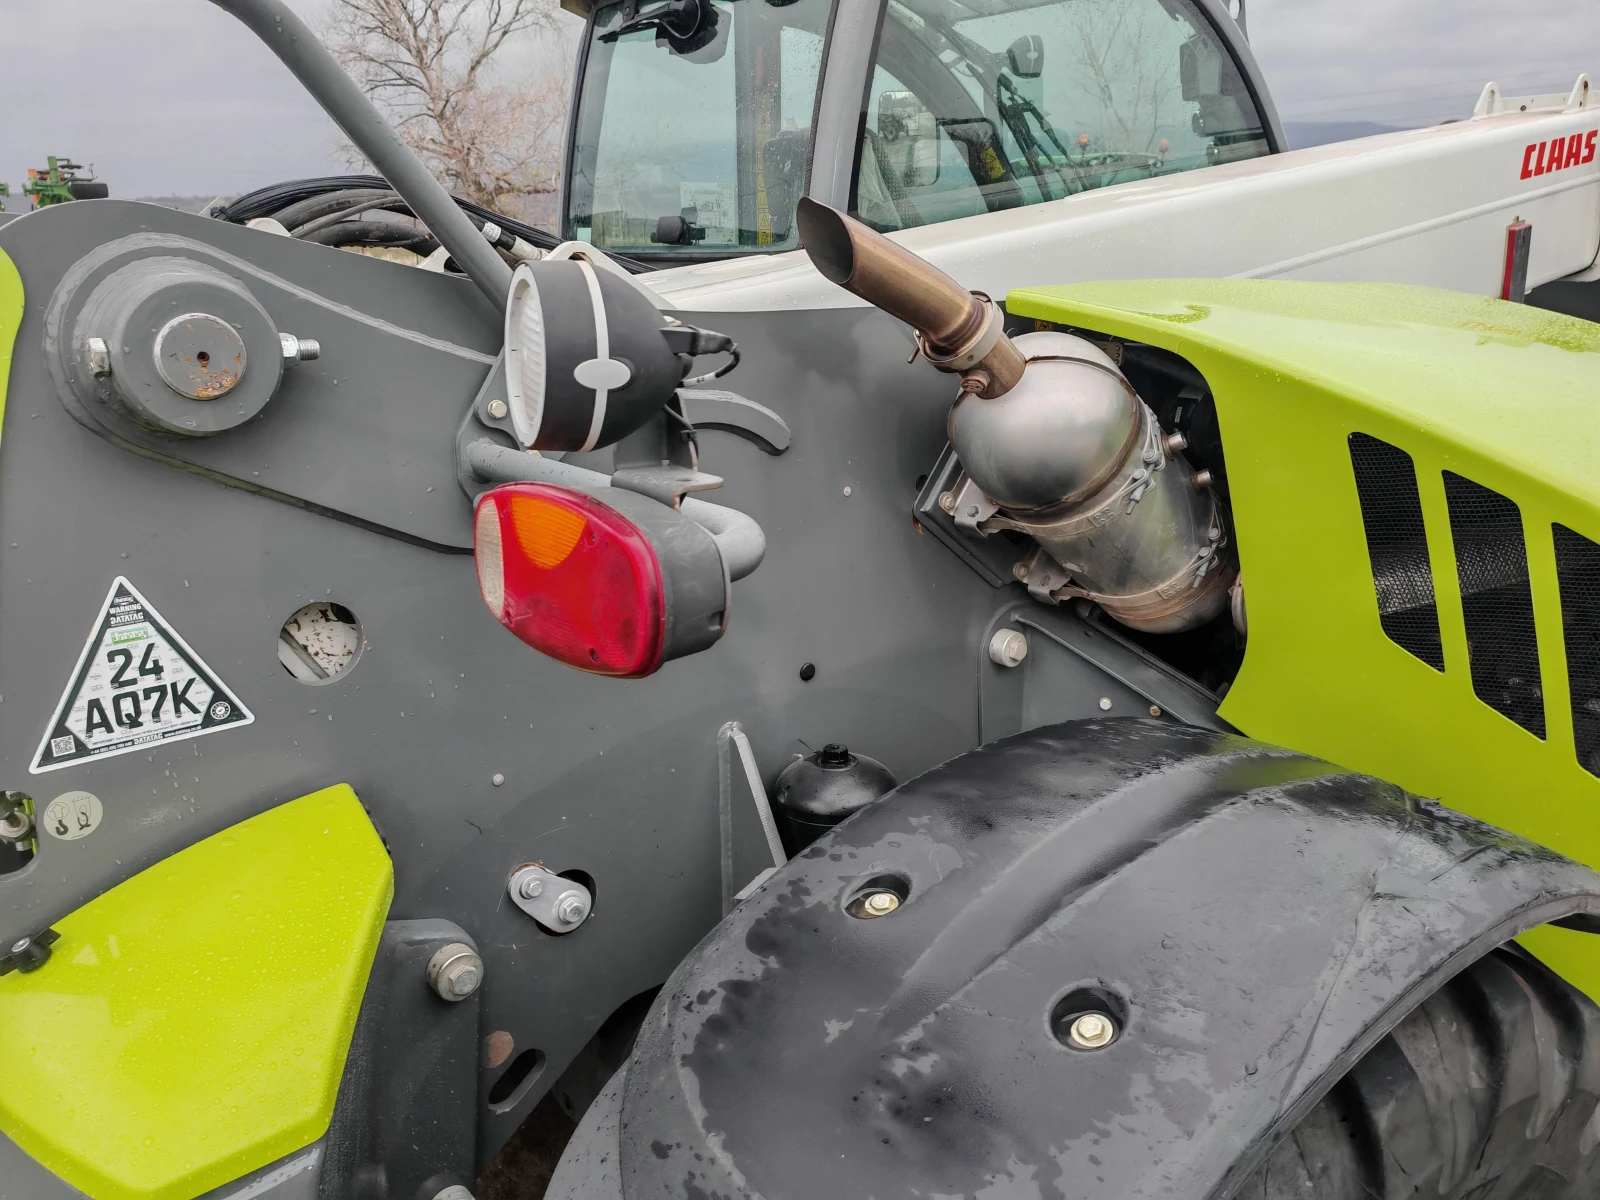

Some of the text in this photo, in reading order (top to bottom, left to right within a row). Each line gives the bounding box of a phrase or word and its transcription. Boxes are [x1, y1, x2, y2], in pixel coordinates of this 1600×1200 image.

[1520, 129, 1599, 181] CLAAS
[109, 603, 142, 614] WARNING
[106, 642, 164, 689] 24
[85, 677, 202, 738] AQ7K
